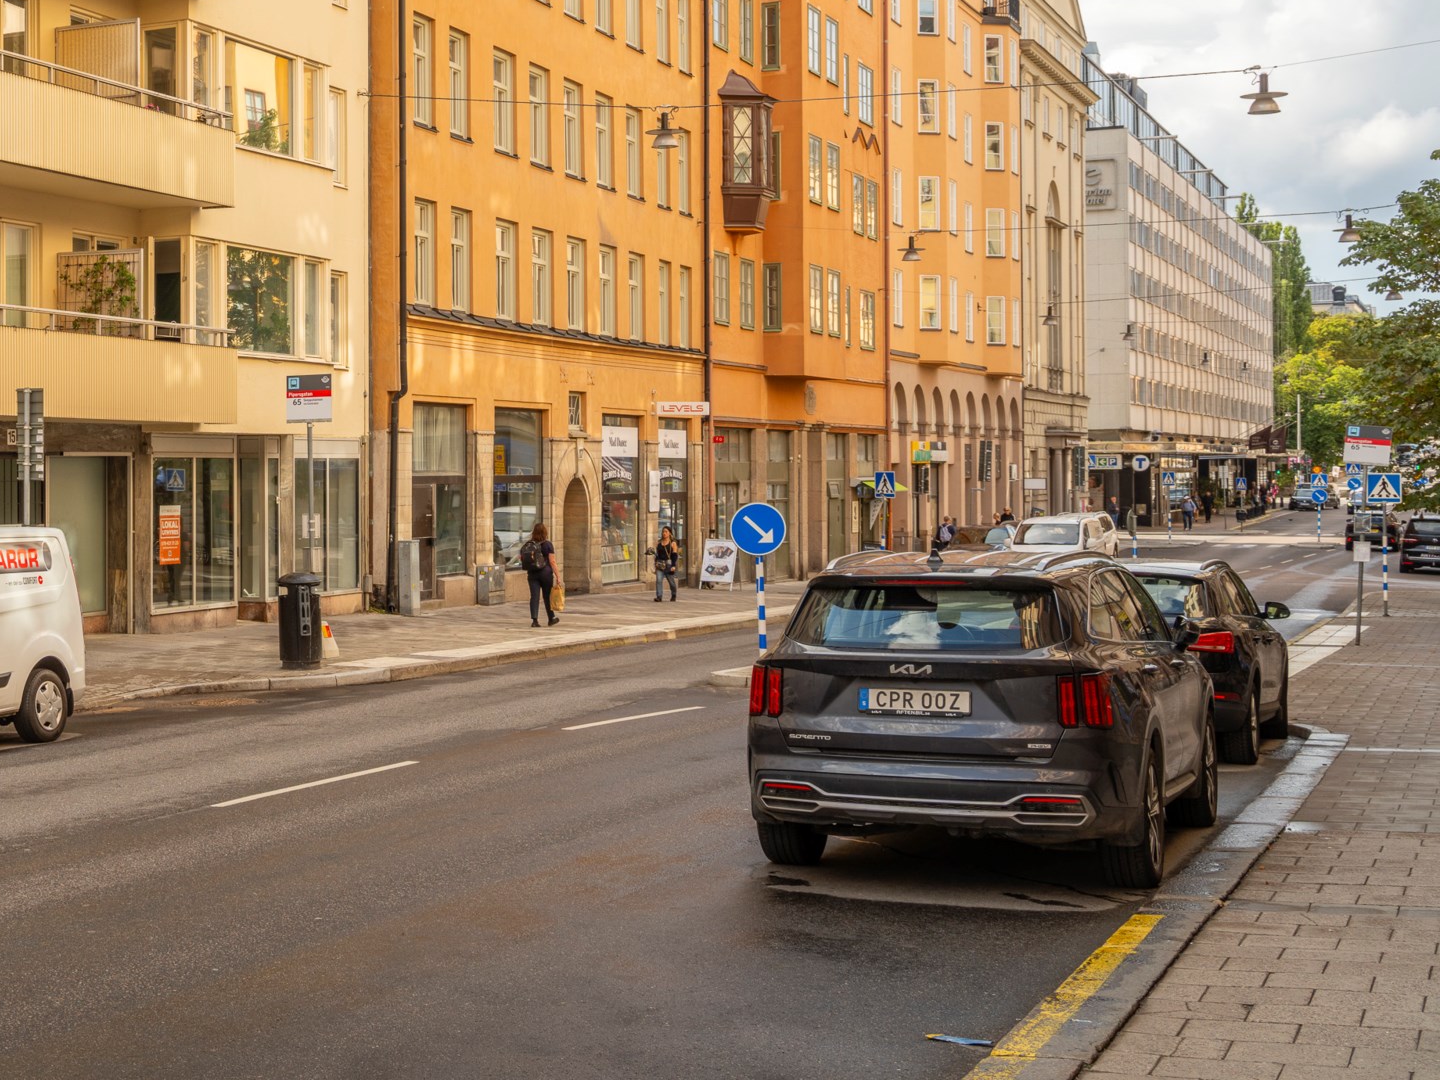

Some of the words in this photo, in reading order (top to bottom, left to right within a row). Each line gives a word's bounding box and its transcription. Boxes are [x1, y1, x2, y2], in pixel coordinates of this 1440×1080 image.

[662, 404, 704, 413] LEVELS
[8, 431, 16, 444] 15
[1135, 458, 1146, 469] T
[889, 663, 933, 675] KIA
[876, 690, 914, 709] CPR
[789, 732, 832, 741] SORENTO
